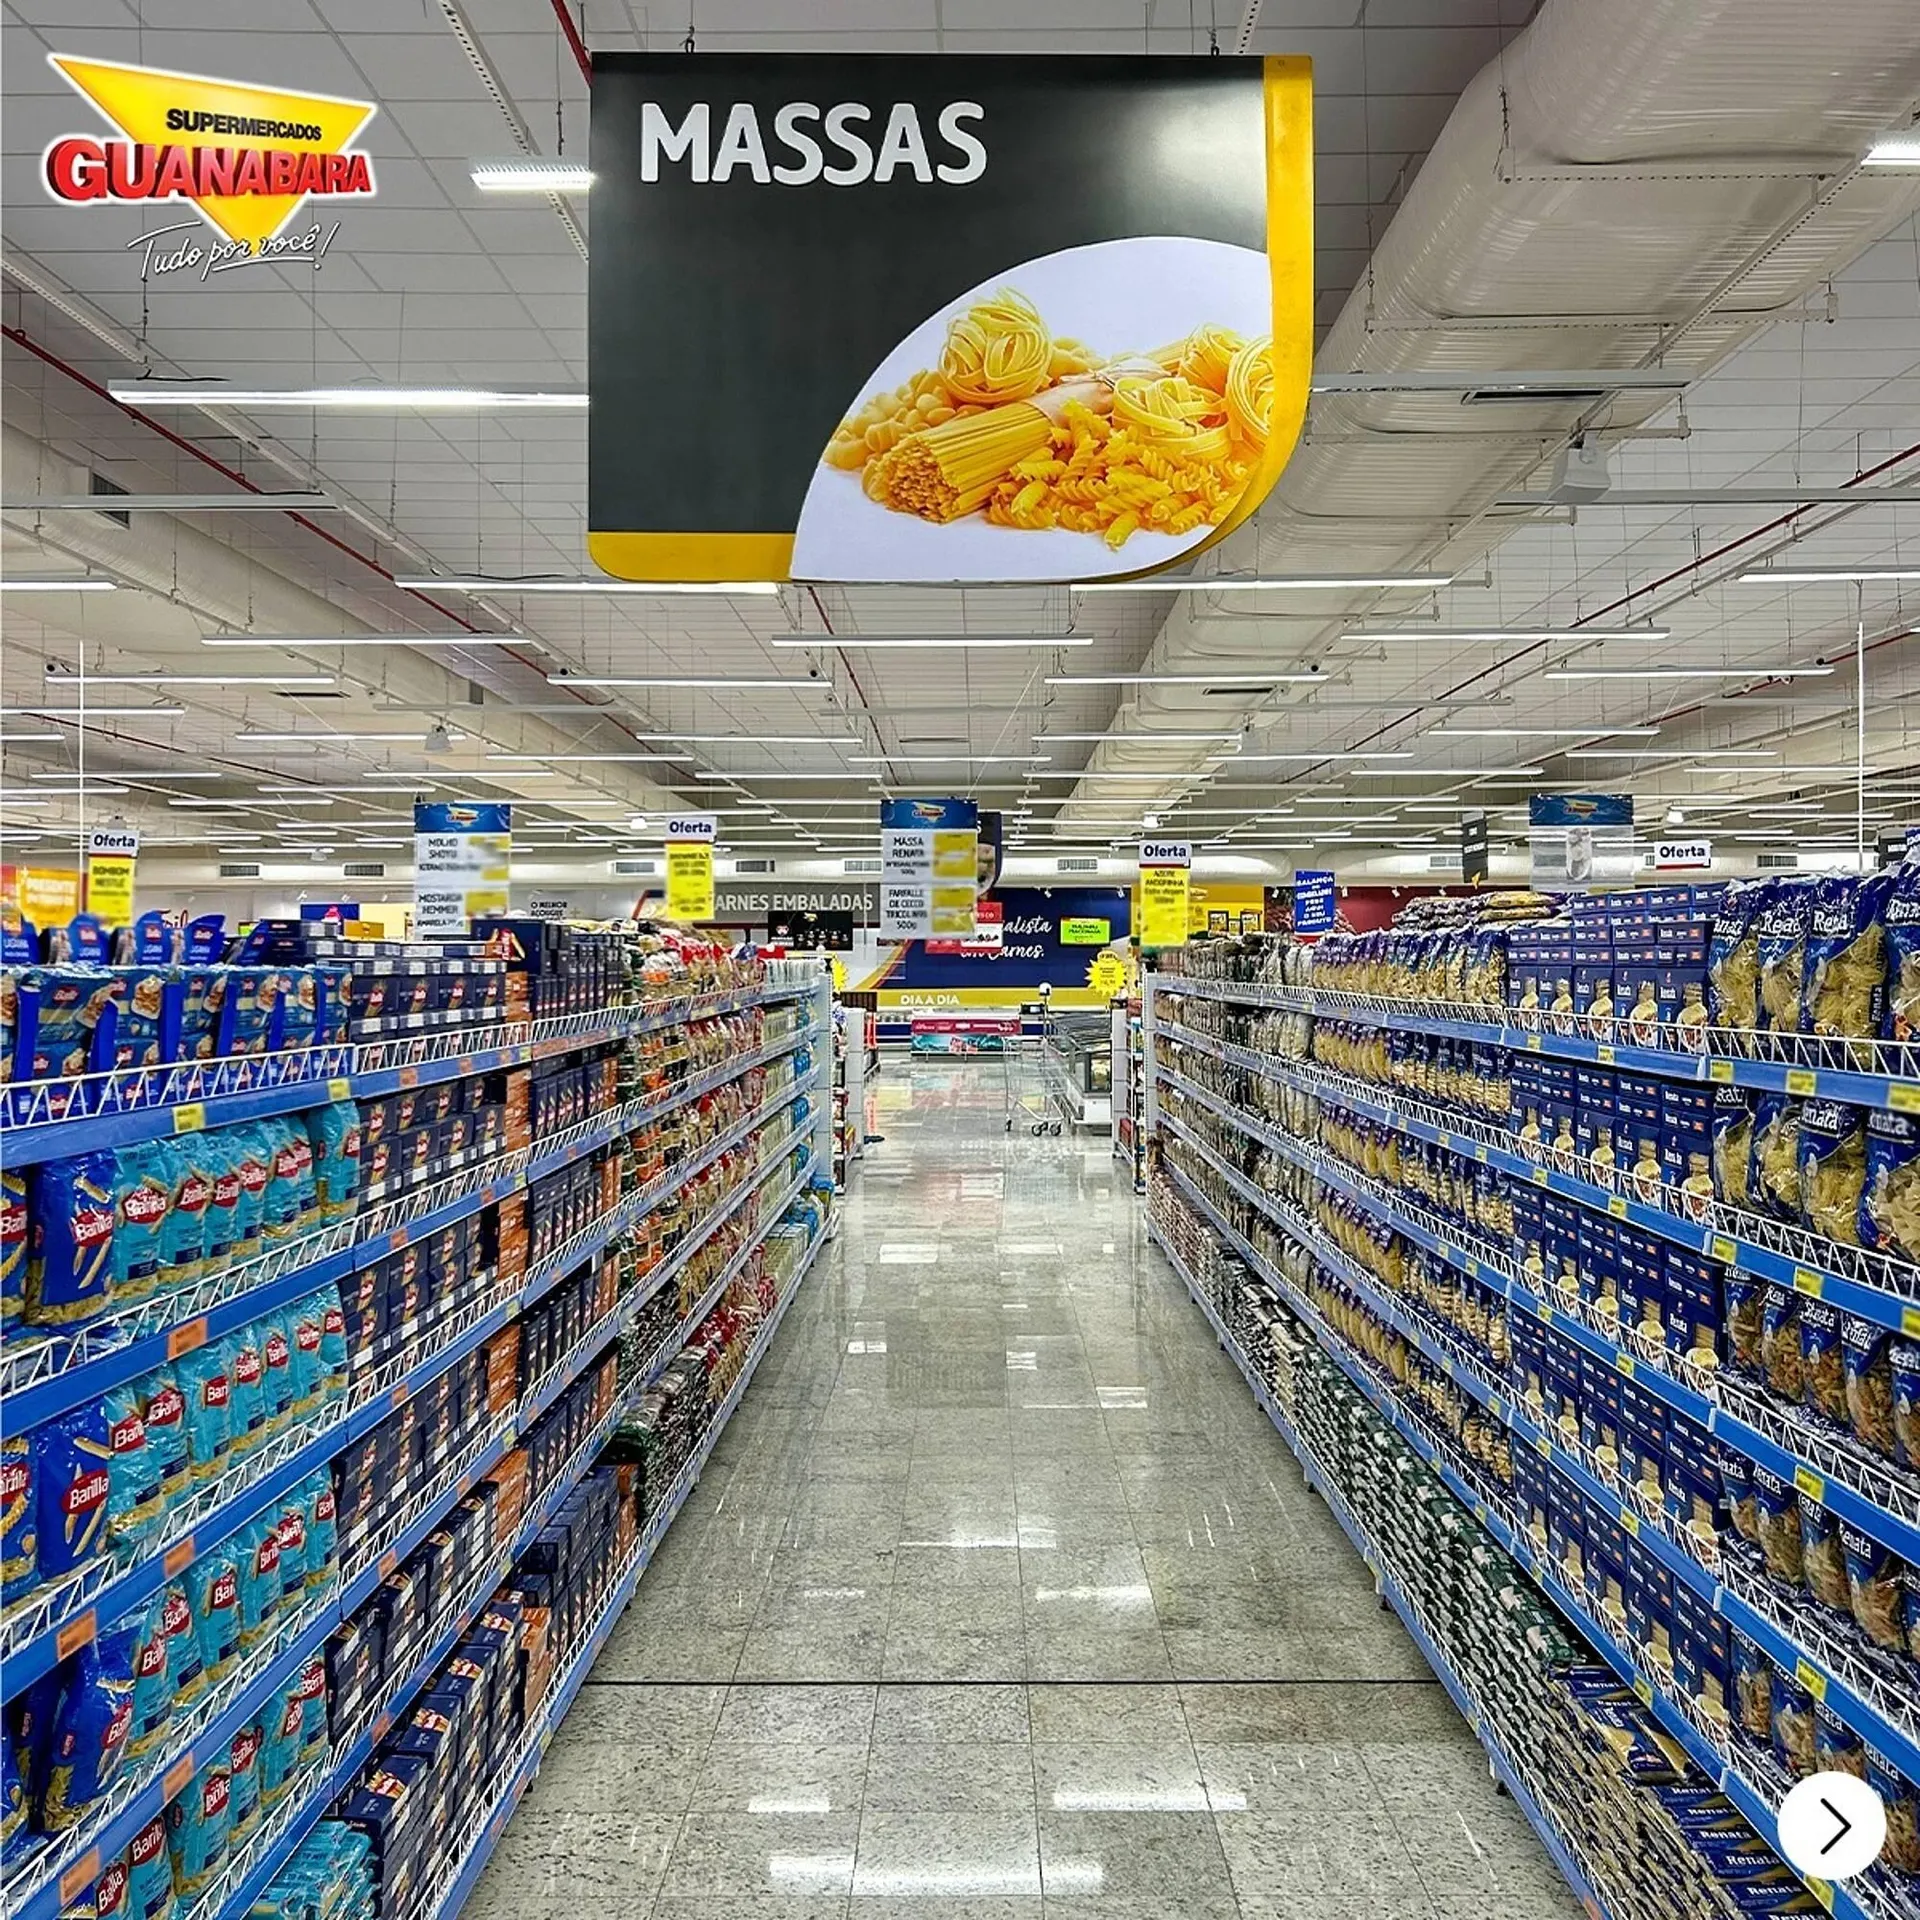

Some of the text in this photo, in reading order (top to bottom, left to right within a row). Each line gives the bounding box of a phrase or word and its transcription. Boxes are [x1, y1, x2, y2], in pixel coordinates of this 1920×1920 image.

[641, 102, 988, 186] MASSAS
[669, 821, 712, 833] Oferta
[94, 834, 136, 847] Oferta
[893, 837, 924, 846] MASSA
[892, 848, 925, 858] RENATA
[1144, 845, 1187, 857] Oferta
[1660, 845, 1706, 858] Oferta
[714, 894, 874, 911] ARNES EMBALADAS
[900, 995, 960, 1005] DIA A DIA
[69, 1476, 109, 1510] Barilla
[1725, 1854, 1780, 1867] Renata
[1747, 1885, 1803, 1896] Renata
